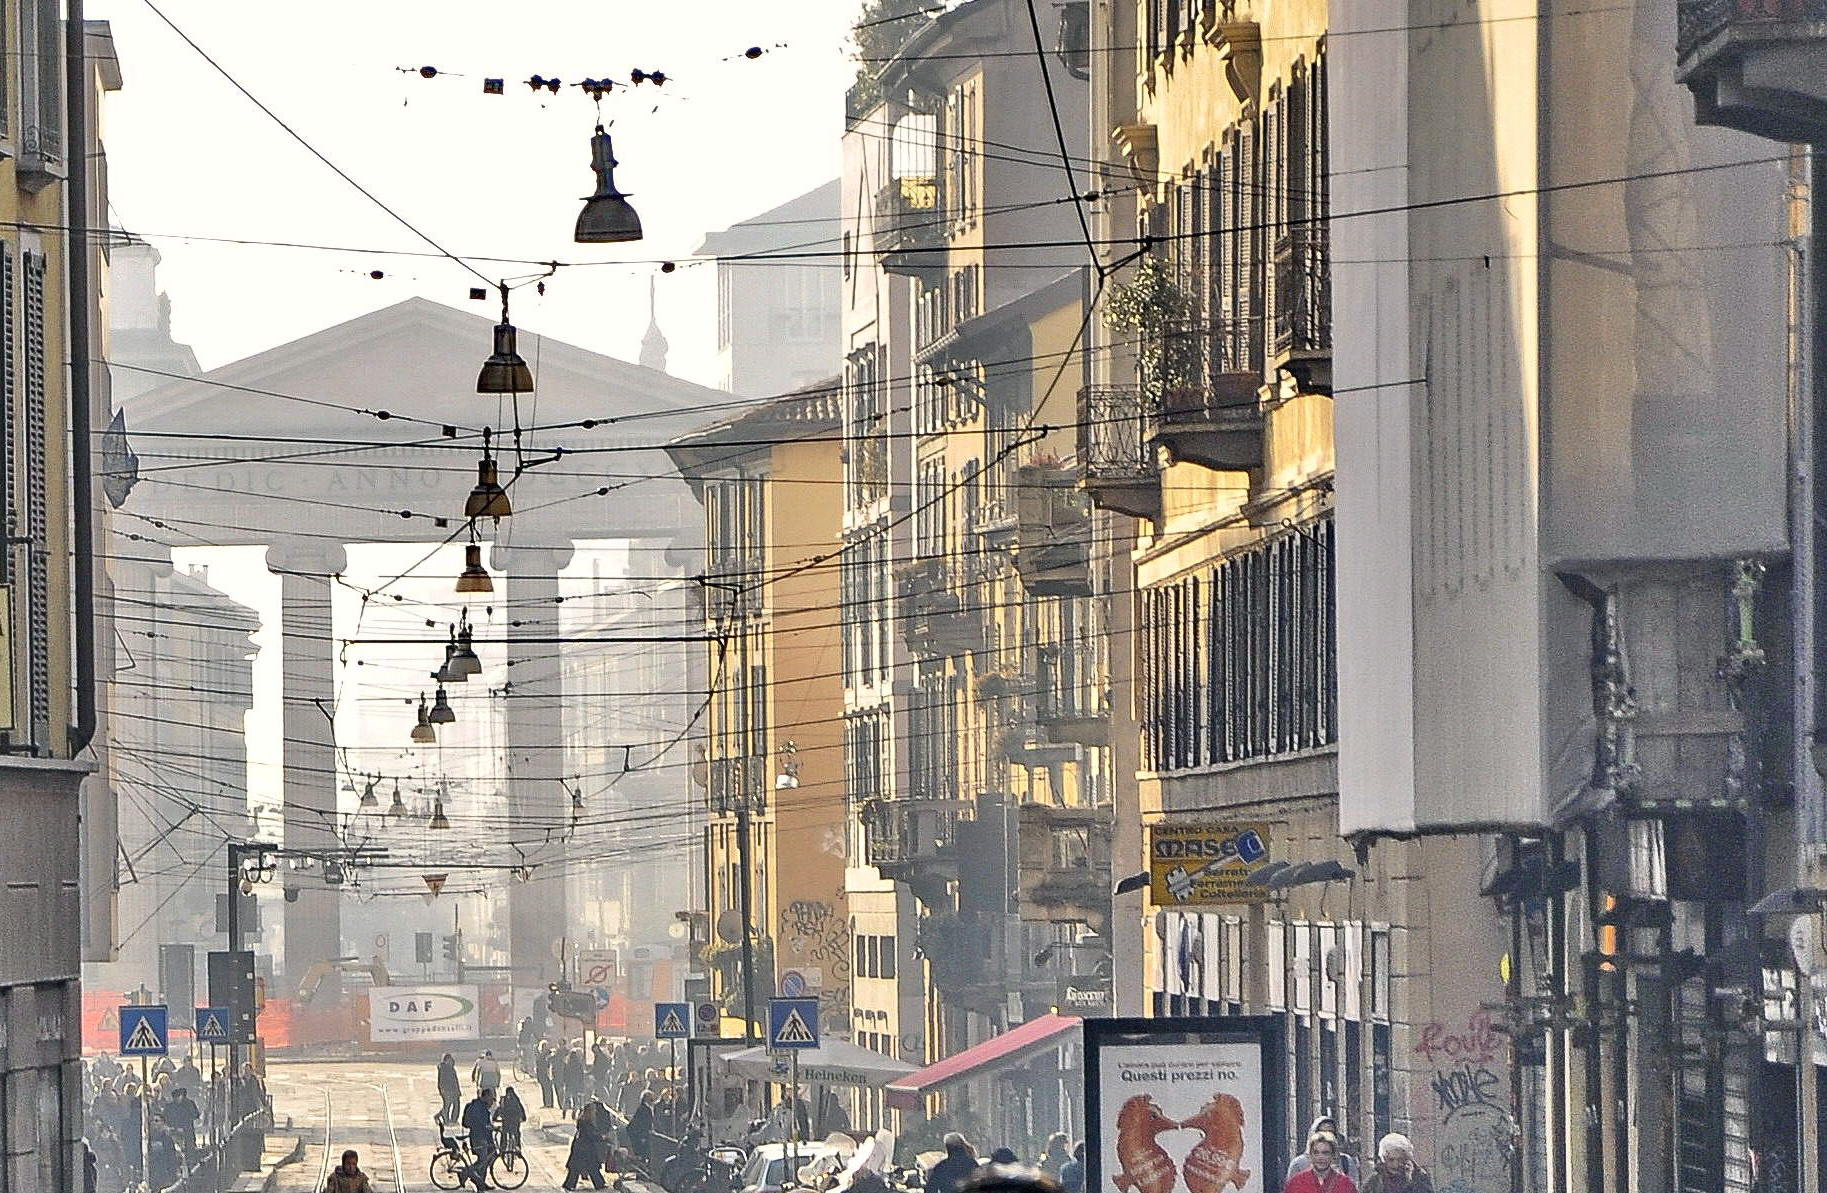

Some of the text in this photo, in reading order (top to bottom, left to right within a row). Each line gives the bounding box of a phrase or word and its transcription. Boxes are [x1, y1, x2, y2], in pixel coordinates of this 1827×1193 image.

[804, 1068, 867, 1084] Heineken
[1121, 1068, 1239, 1084] Questi prezzi no.
